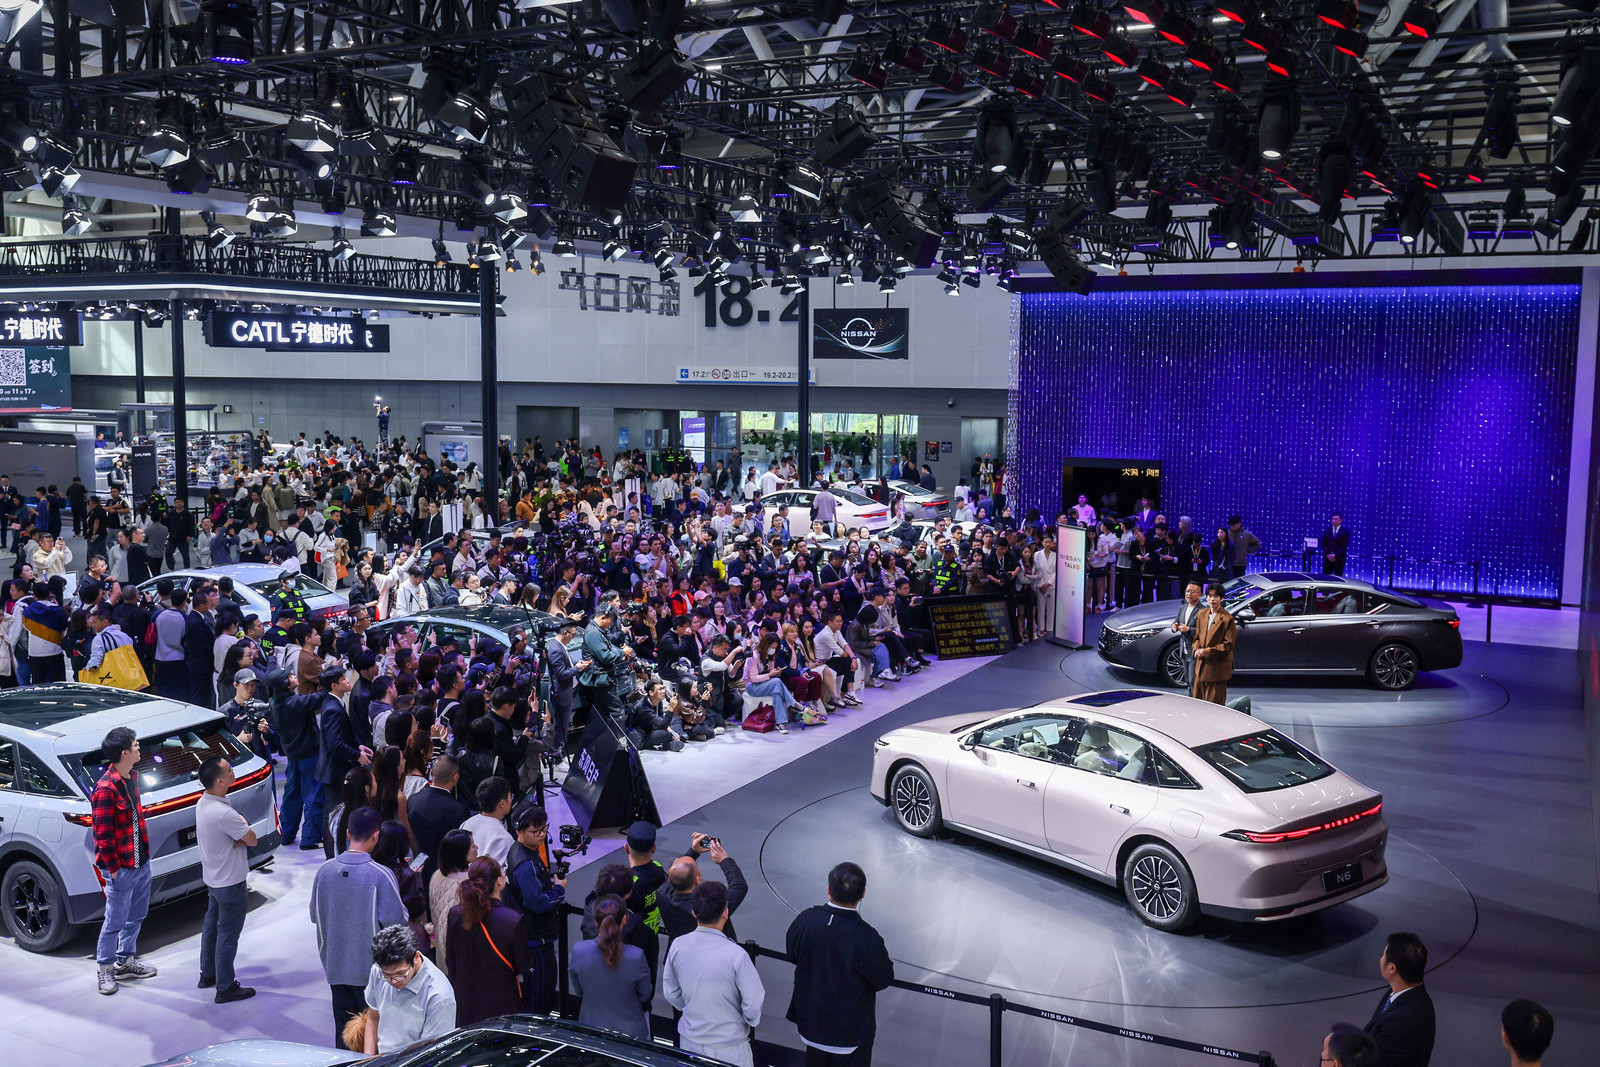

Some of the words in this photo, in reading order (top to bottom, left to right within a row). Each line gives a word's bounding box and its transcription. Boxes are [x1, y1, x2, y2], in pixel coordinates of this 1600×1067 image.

[4, 317, 63, 340] 宁德时代
[231, 320, 291, 343] CATL
[291, 320, 354, 345] 宁德时代
[28, 359, 53, 374] 签到
[733, 370, 748, 378] 出口
[1060, 554, 1081, 563] NISSAN
[1323, 814, 1361, 830] NISSAN
[1336, 872, 1352, 884] N6
[924, 986, 955, 998] NISSAN
[1040, 1011, 1074, 1024] NISSAN
[1119, 1029, 1154, 1041] NISSAN
[1203, 1046, 1239, 1058] NISSAN
